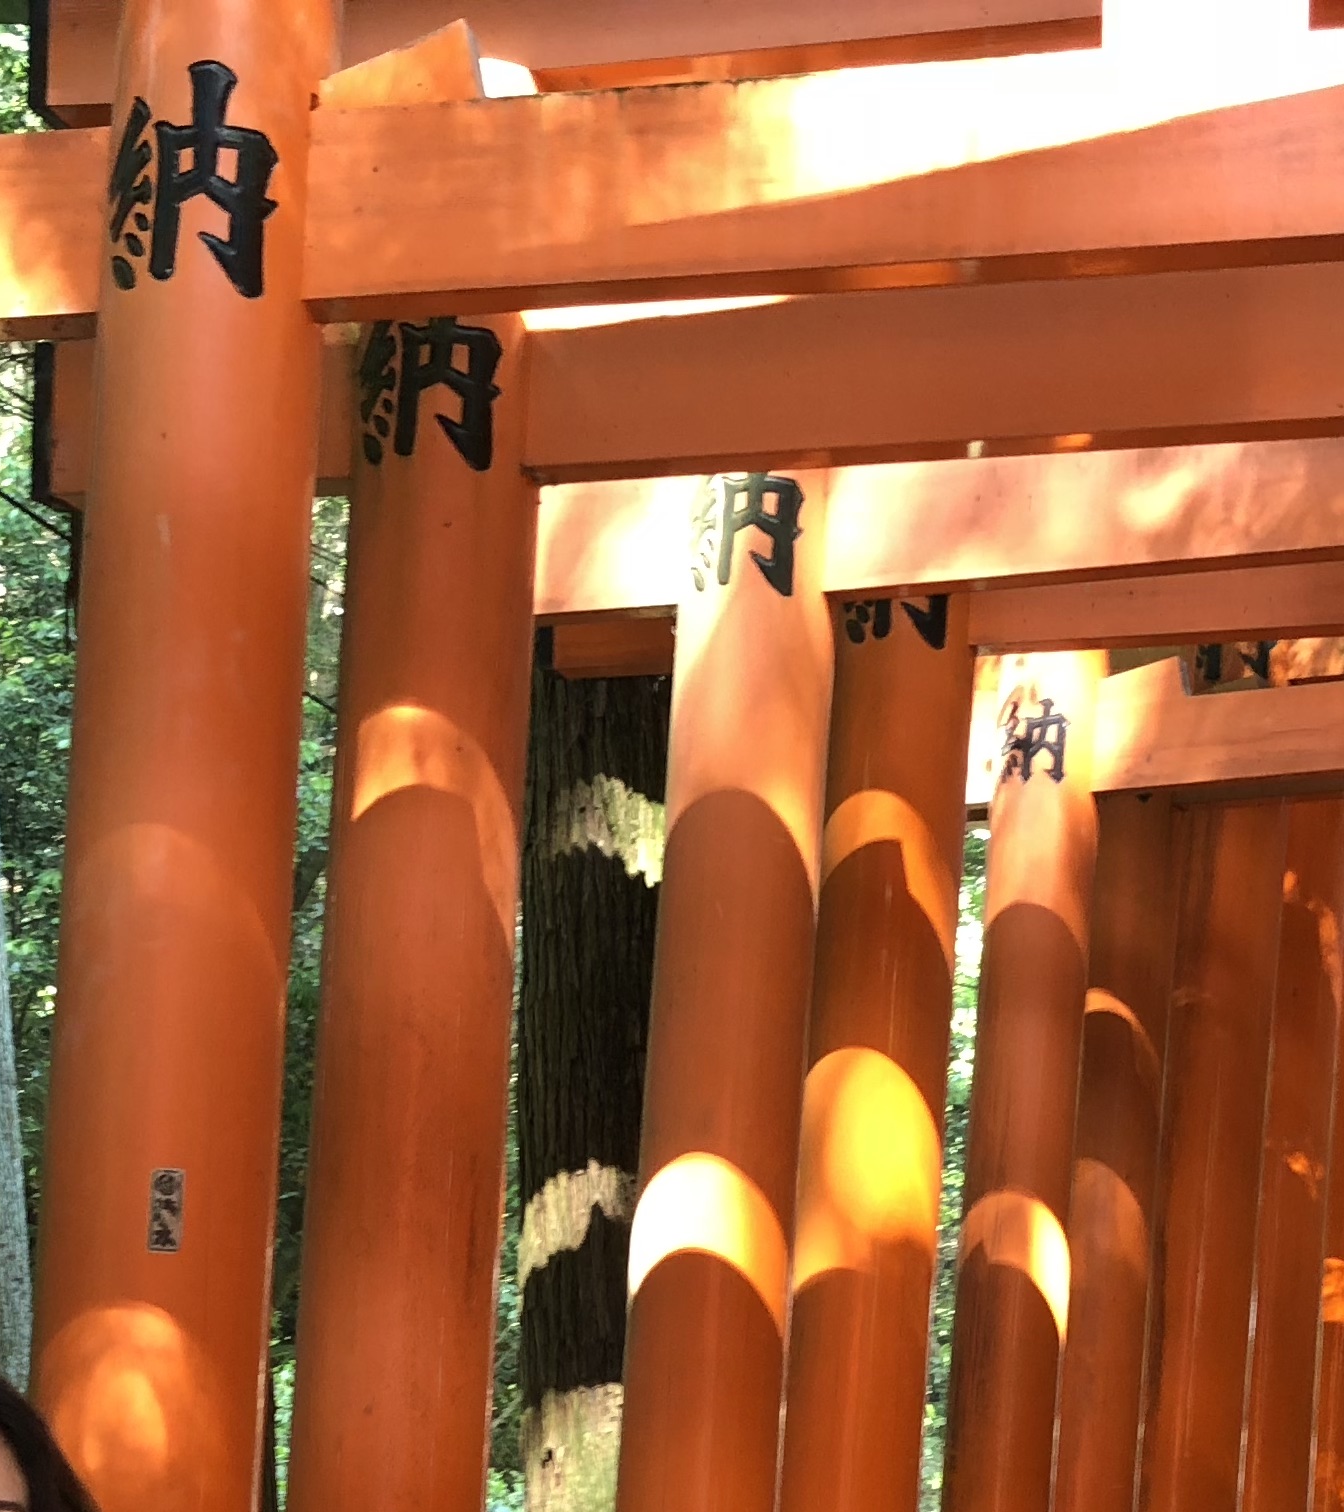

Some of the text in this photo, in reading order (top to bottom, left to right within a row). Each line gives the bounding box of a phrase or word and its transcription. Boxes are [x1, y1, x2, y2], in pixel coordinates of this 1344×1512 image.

[109, 60, 279, 299] 納
[359, 316, 503, 472] 納
[998, 697, 1070, 785] 納
